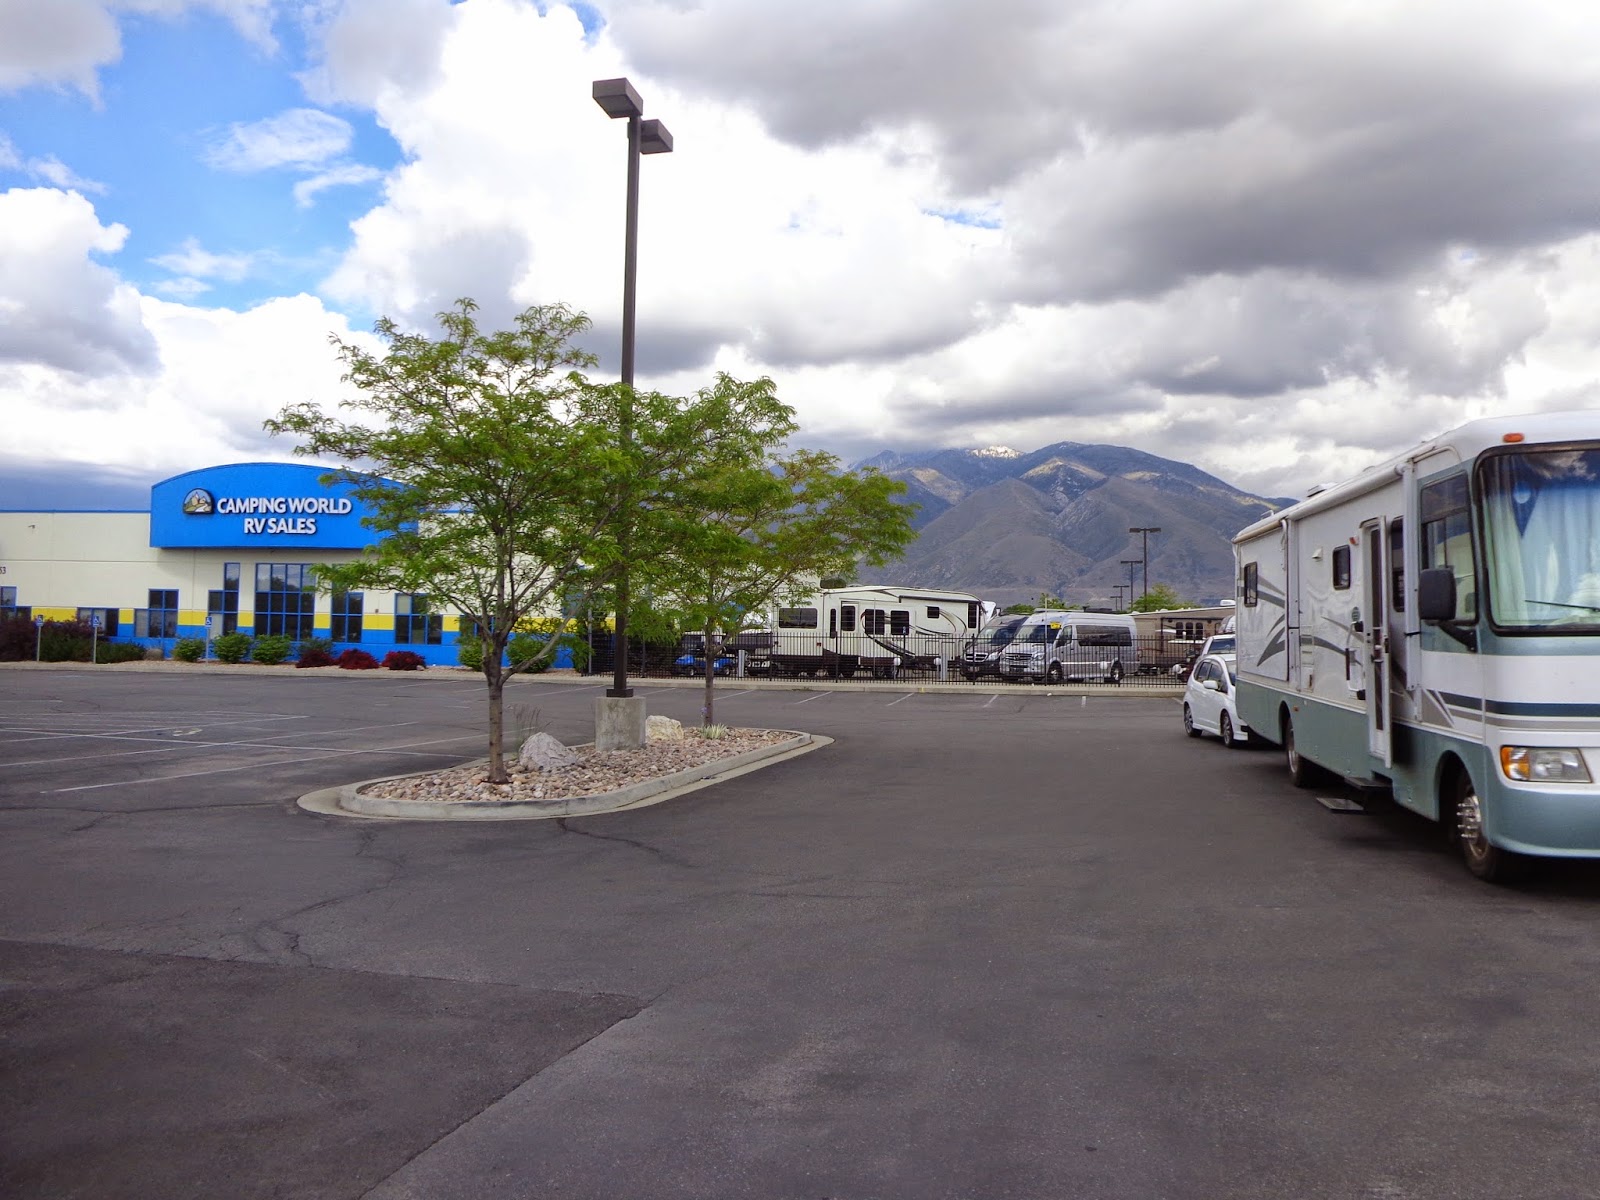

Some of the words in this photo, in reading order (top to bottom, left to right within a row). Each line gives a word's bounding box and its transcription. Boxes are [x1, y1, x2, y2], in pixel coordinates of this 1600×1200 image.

[217, 498, 287, 514] CAMPING
[287, 498, 352, 515] WORLD
[244, 518, 266, 534] RV
[267, 518, 317, 535] SALES
